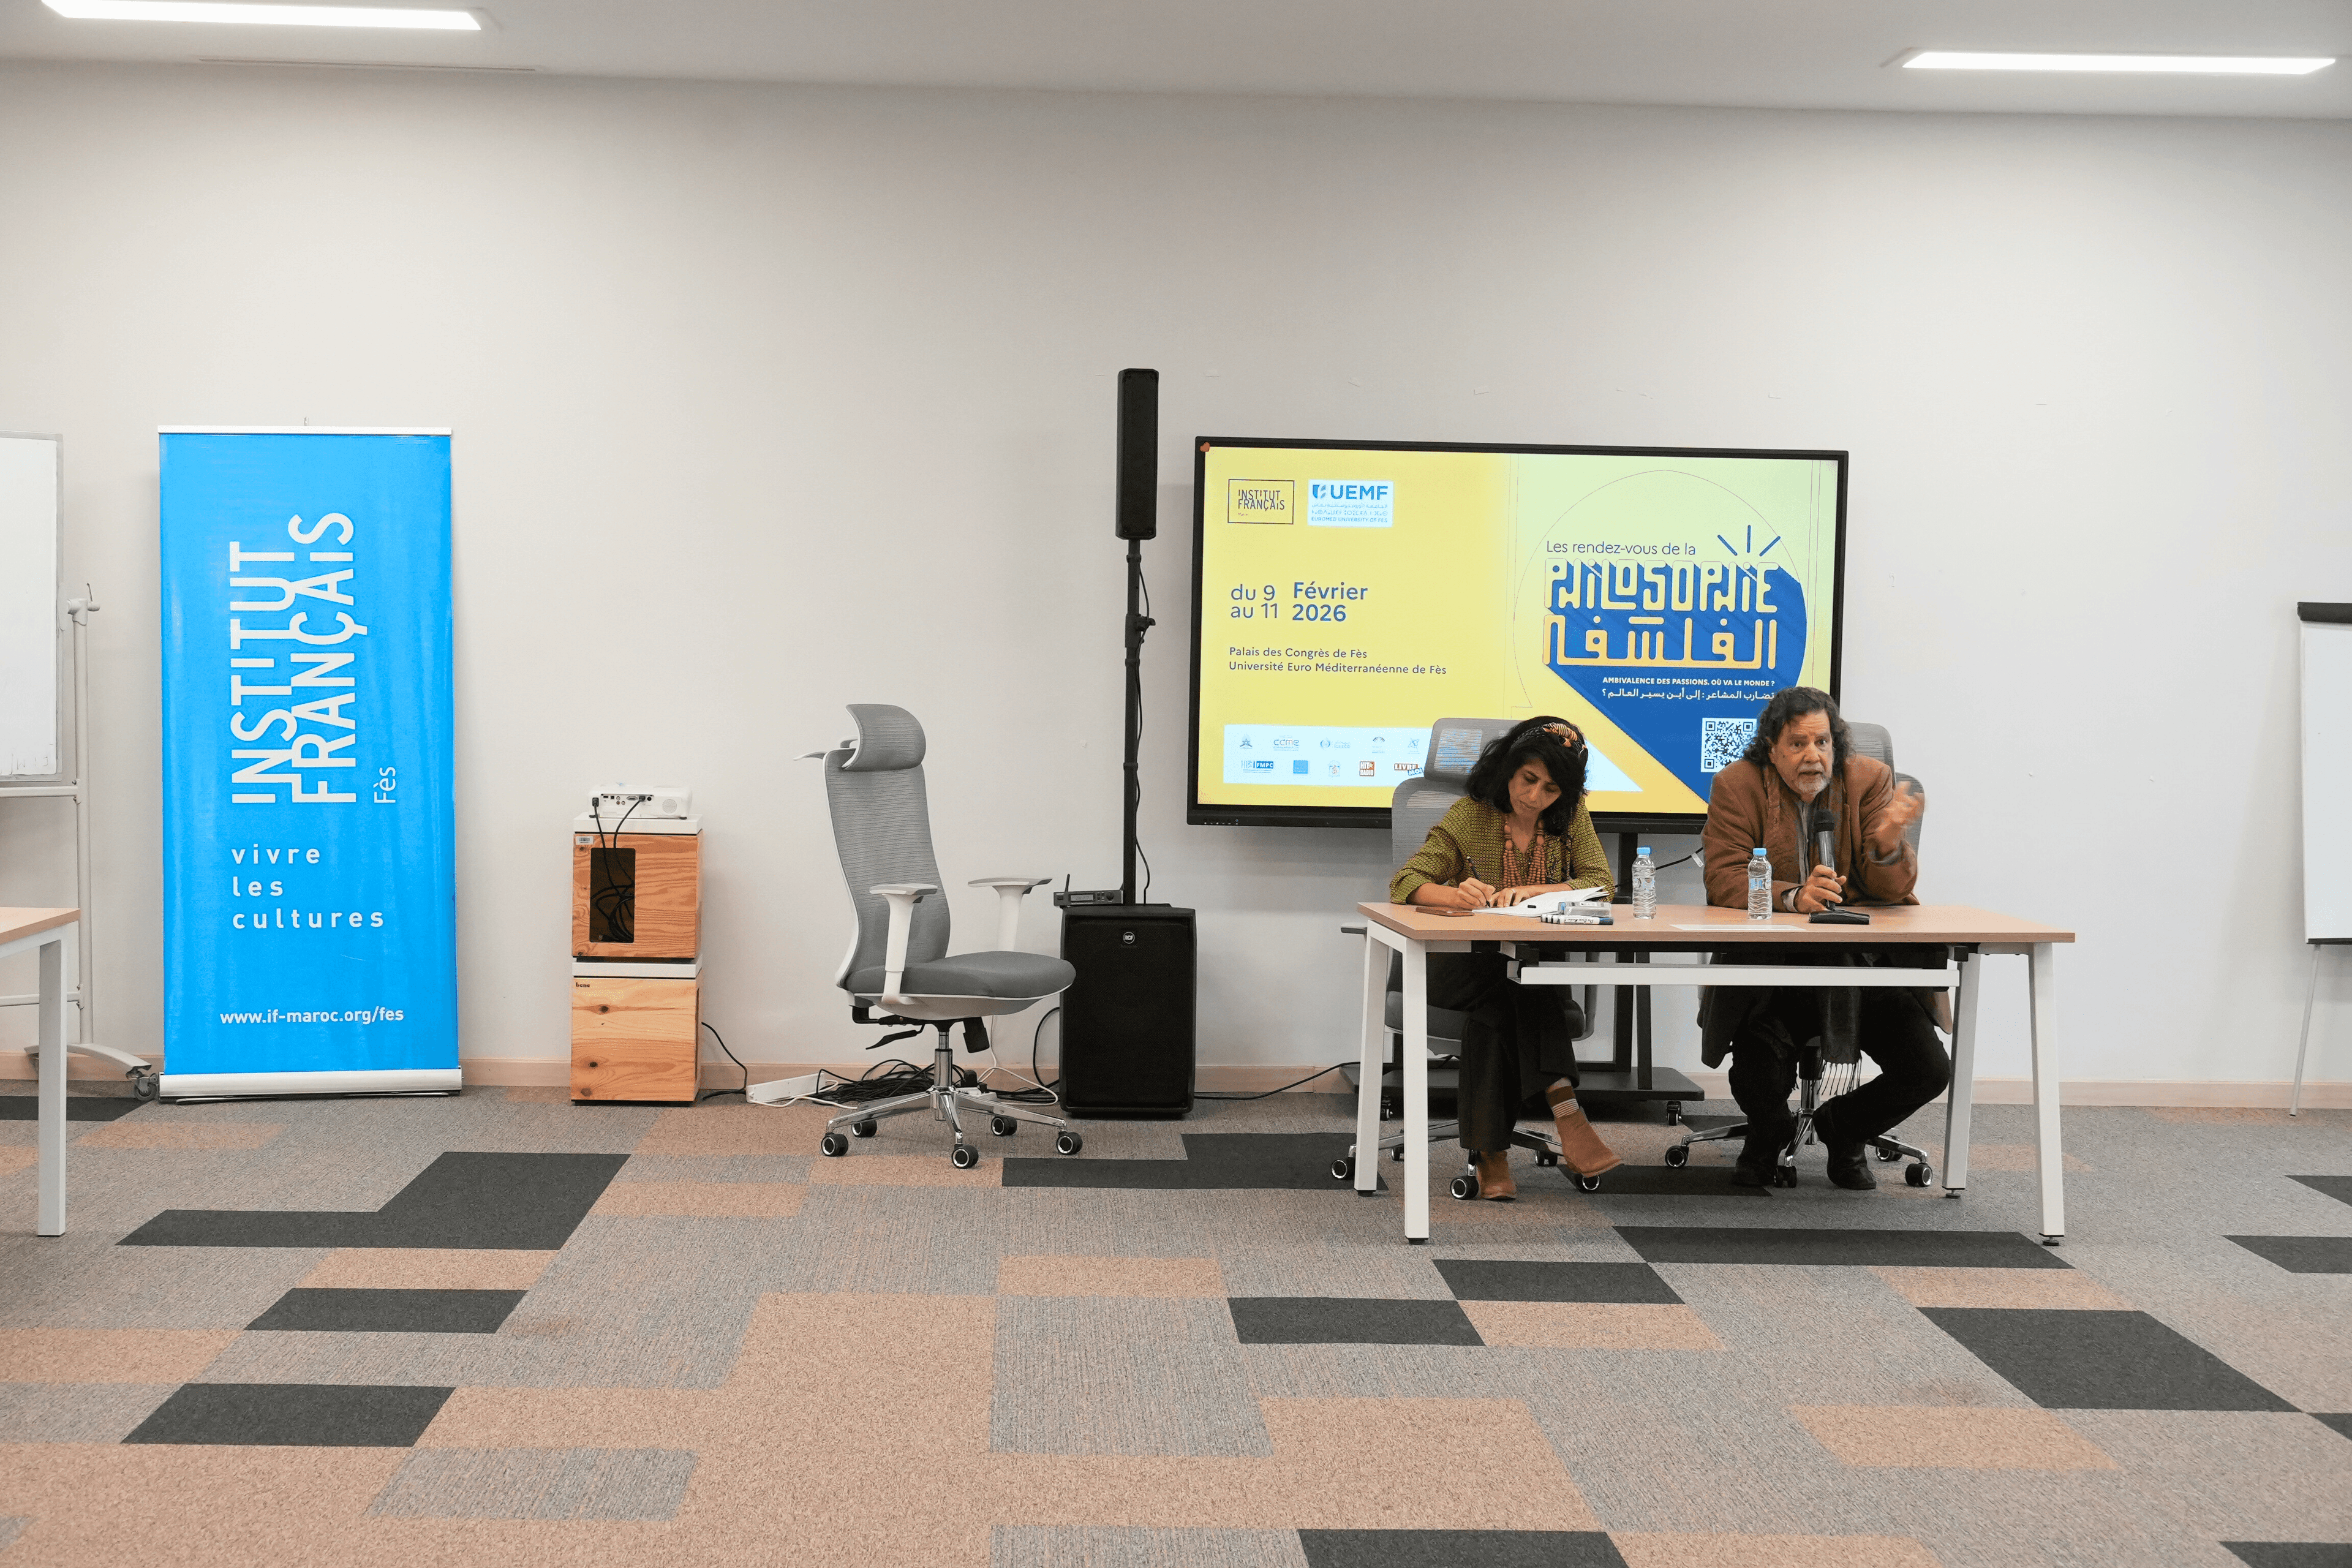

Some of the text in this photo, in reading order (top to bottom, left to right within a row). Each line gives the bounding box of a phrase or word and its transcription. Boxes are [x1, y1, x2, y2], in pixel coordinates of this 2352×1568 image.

[1238, 489, 1281, 500] INSTITUT
[1330, 484, 1389, 500] UEMF
[1238, 499, 1285, 512] FRANÇAIS
[1547, 541, 1695, 556] Les rendez-vous de la
[1231, 584, 1276, 601] du 9
[1293, 581, 1368, 600] Février
[1231, 603, 1278, 619] au 11
[1292, 604, 1346, 622] 2026
[288, 512, 368, 803] FRANÇAIS
[1229, 647, 1367, 660] Palais des Congrès de Fès
[230, 541, 297, 804] INSTITUT
[1229, 661, 1447, 674] Université Euro Méditerranéenne de Fès
[1608, 688, 1639, 699] العالم
[1640, 690, 1665, 700] يسير
[1666, 687, 1685, 699] أين
[1686, 690, 1700, 700] إلى
[1706, 689, 1742, 701] المشاعر
[1743, 690, 1774, 701] تضارب
[374, 766, 396, 804] Fès
[231, 843, 320, 864] vivre
[233, 876, 283, 897] les
[232, 908, 384, 930] cultures
[219, 1006, 404, 1025] www.if-maroc.org/fes
